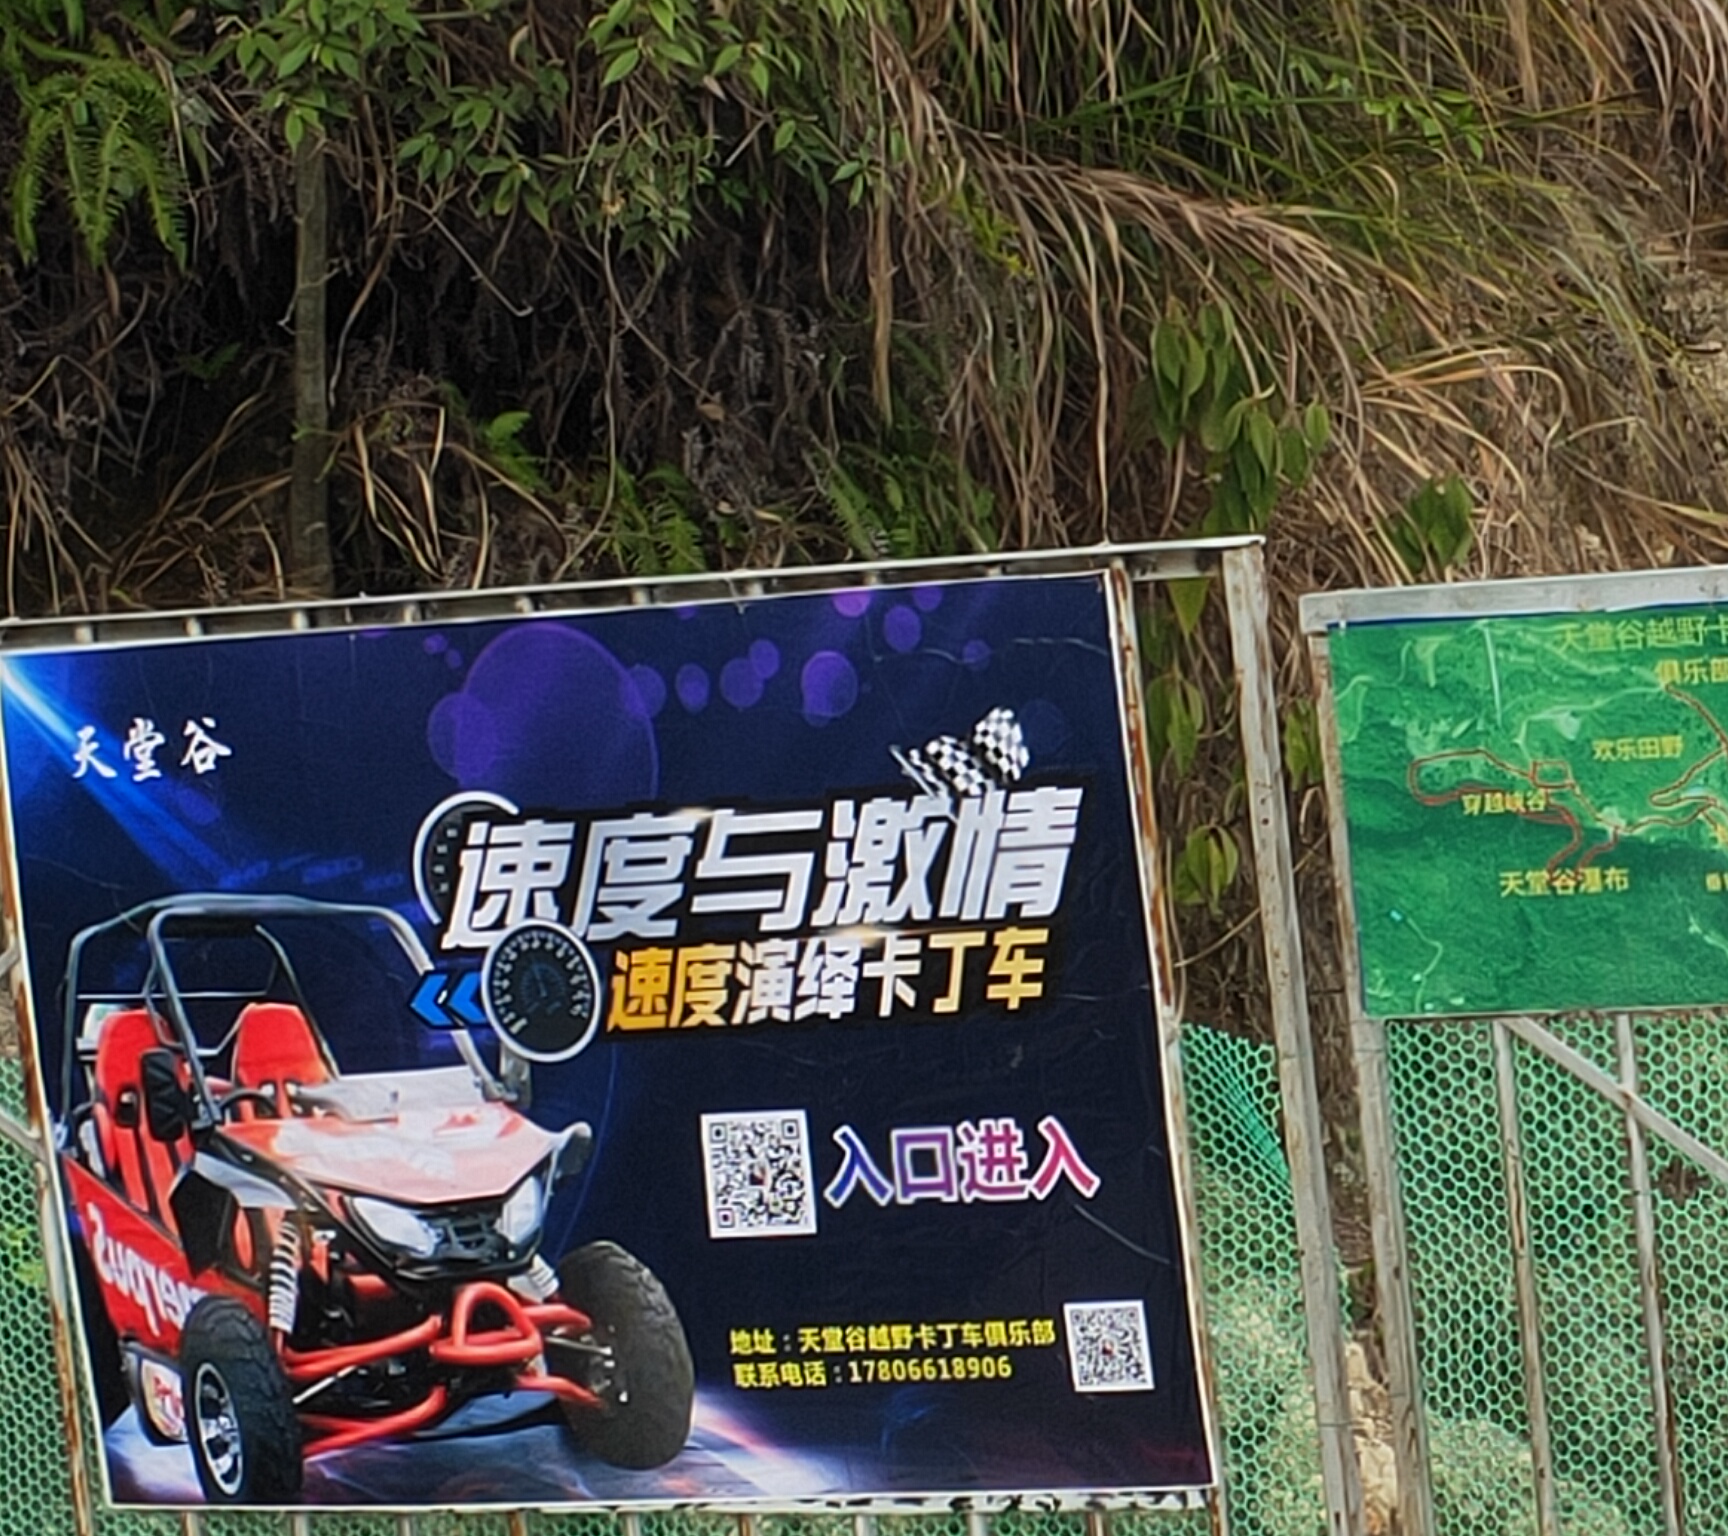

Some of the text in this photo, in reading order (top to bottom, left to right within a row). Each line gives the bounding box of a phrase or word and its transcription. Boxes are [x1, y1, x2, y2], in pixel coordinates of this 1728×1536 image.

[72, 716, 233, 783] 天堂谷
[1592, 735, 1684, 762] 欢乐田野
[441, 786, 1083, 948] 速度与激情
[1498, 866, 1629, 898] 天堂谷瀑布
[607, 926, 1049, 1033] 速度演绎卡丁车
[824, 1115, 1101, 1208] 入口进入
